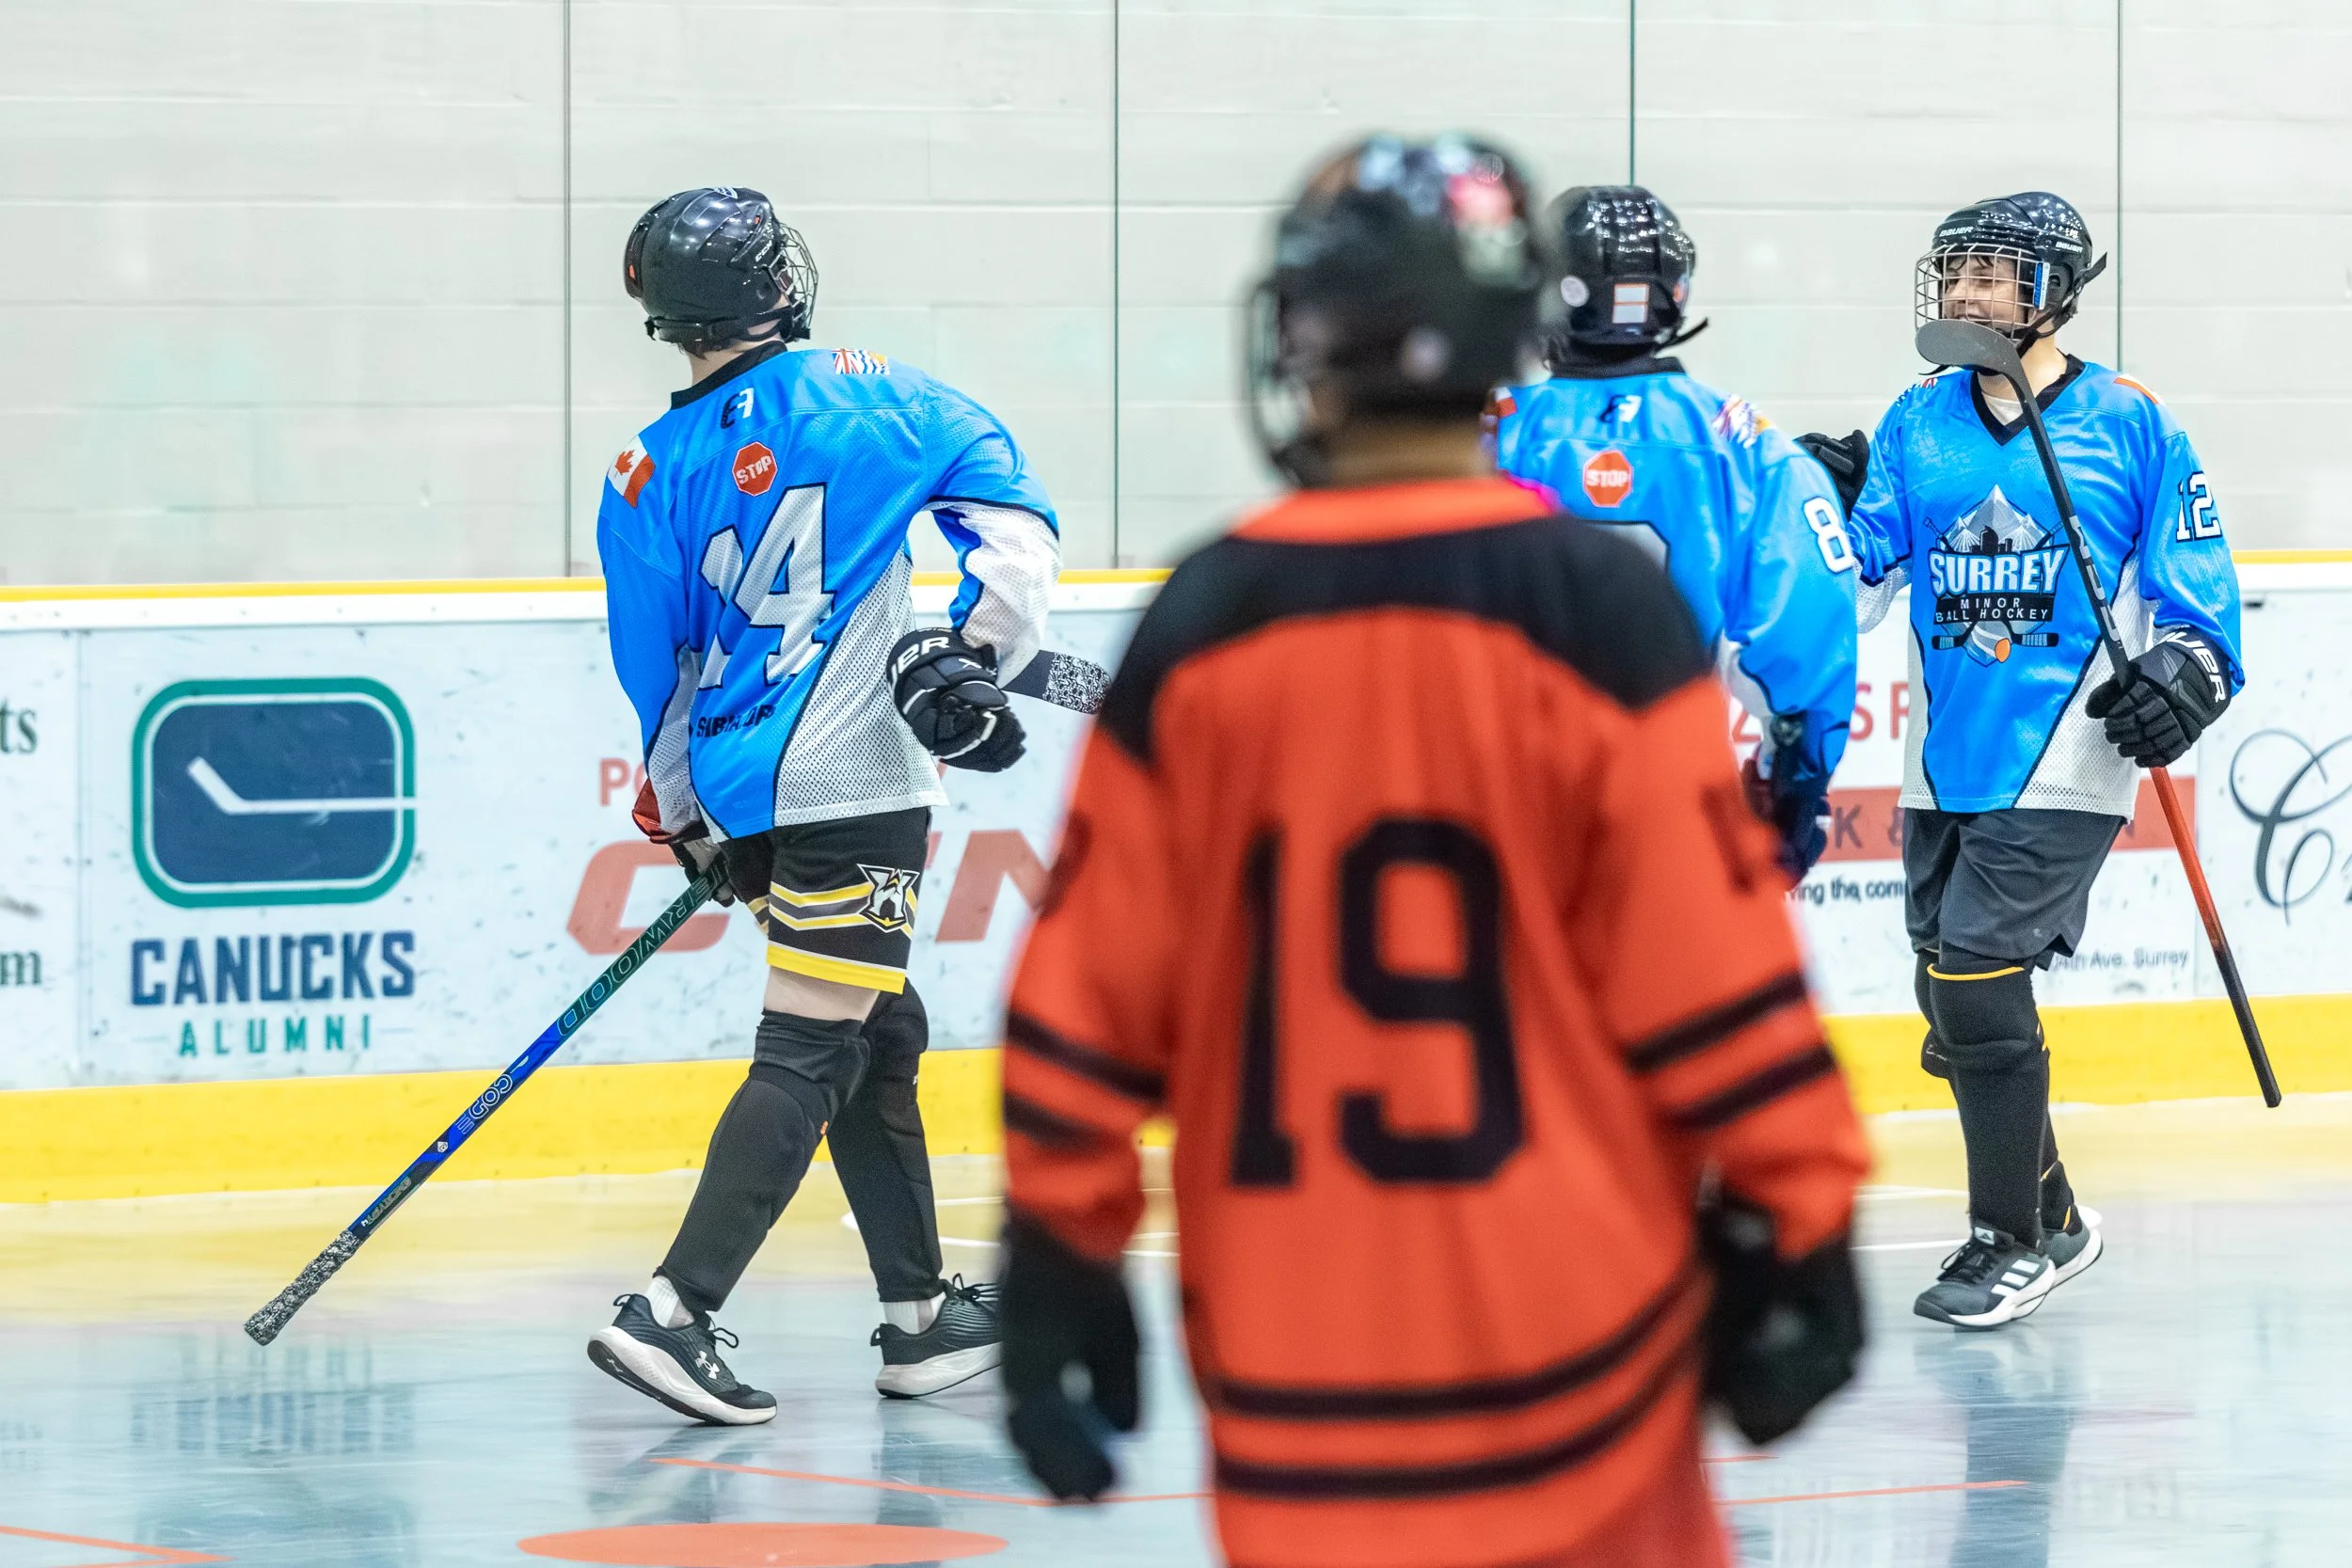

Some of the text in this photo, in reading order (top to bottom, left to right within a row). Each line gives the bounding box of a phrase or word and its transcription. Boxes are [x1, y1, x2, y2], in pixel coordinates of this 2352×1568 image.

[736, 455, 772, 484] STOP
[1586, 469, 1629, 487] STOP
[2175, 471, 2222, 543] 12
[1803, 497, 1853, 573] 8
[697, 482, 835, 691] 14
[1928, 546, 2068, 596] SURREY
[1934, 608, 2048, 623] BALL HOCKEY
[1960, 597, 2021, 610] MINOR
[131, 930, 416, 1006] CANUCKS
[1228, 809, 1532, 1191] 19
[179, 1014, 372, 1056] ALUMNI
